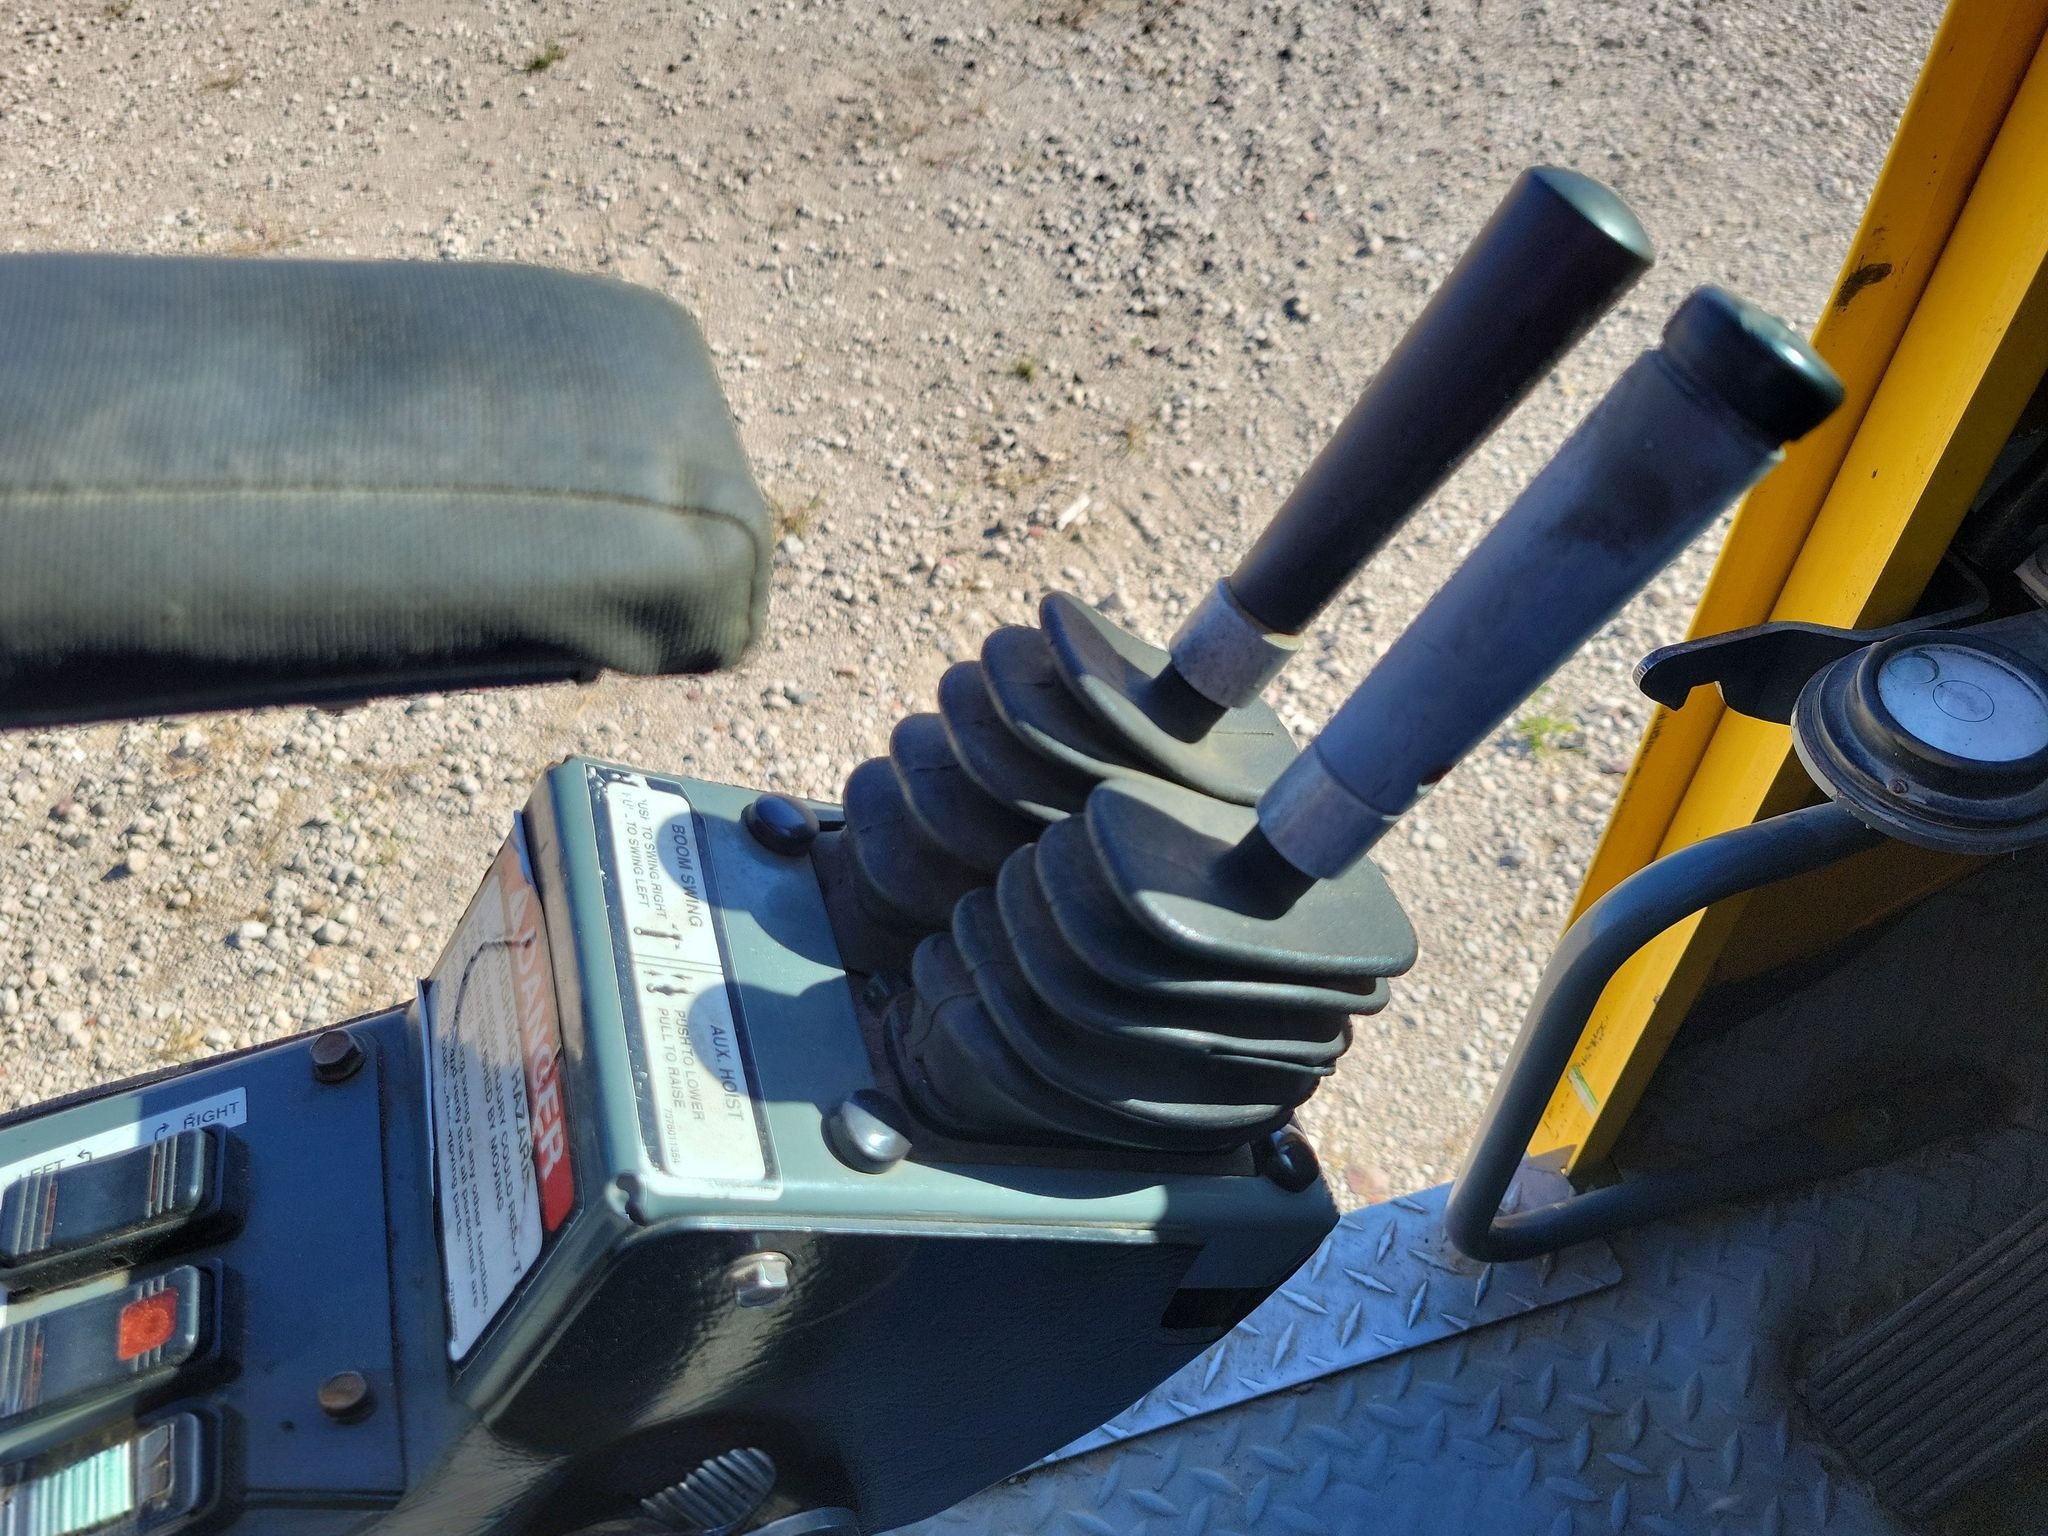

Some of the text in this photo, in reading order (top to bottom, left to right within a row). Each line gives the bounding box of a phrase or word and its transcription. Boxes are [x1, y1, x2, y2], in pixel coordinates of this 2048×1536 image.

[627, 822, 637, 836] TO
[629, 838, 644, 876] SWING
[643, 827, 652, 841] TO
[646, 842, 659, 880] SWING
[672, 824, 703, 928] BOOM SWING
[636, 879, 650, 908] LEFT
[652, 883, 667, 919] RIGHT
[495, 937, 519, 1066] RUSHING
[449, 1041, 459, 1078] and
[478, 1016, 493, 1104] CRUSHED
[514, 925, 566, 1183] DANGER
[659, 1007, 687, 1109] PULL TO RAISE
[675, 1010, 704, 1121] PUSH TO LOWER
[711, 1025, 744, 1121] AUX. HOIST
[183, 1101, 239, 1129] RIGHT
[451, 1075, 463, 1124] verify
[486, 1104, 496, 1132] BY
[492, 1060, 506, 1129] INJURY
[456, 1122, 466, 1161] that
[499, 1128, 513, 1198] COULD
[460, 1161, 468, 1185] all
[460, 1071, 490, 1315] swing or any other function,
[489, 1133, 504, 1215] MOVING
[452, 1189, 463, 1246] parts.
[461, 1184, 477, 1276] personnel
[505, 1200, 522, 1280] RESUT
[470, 1276, 479, 1309] are
